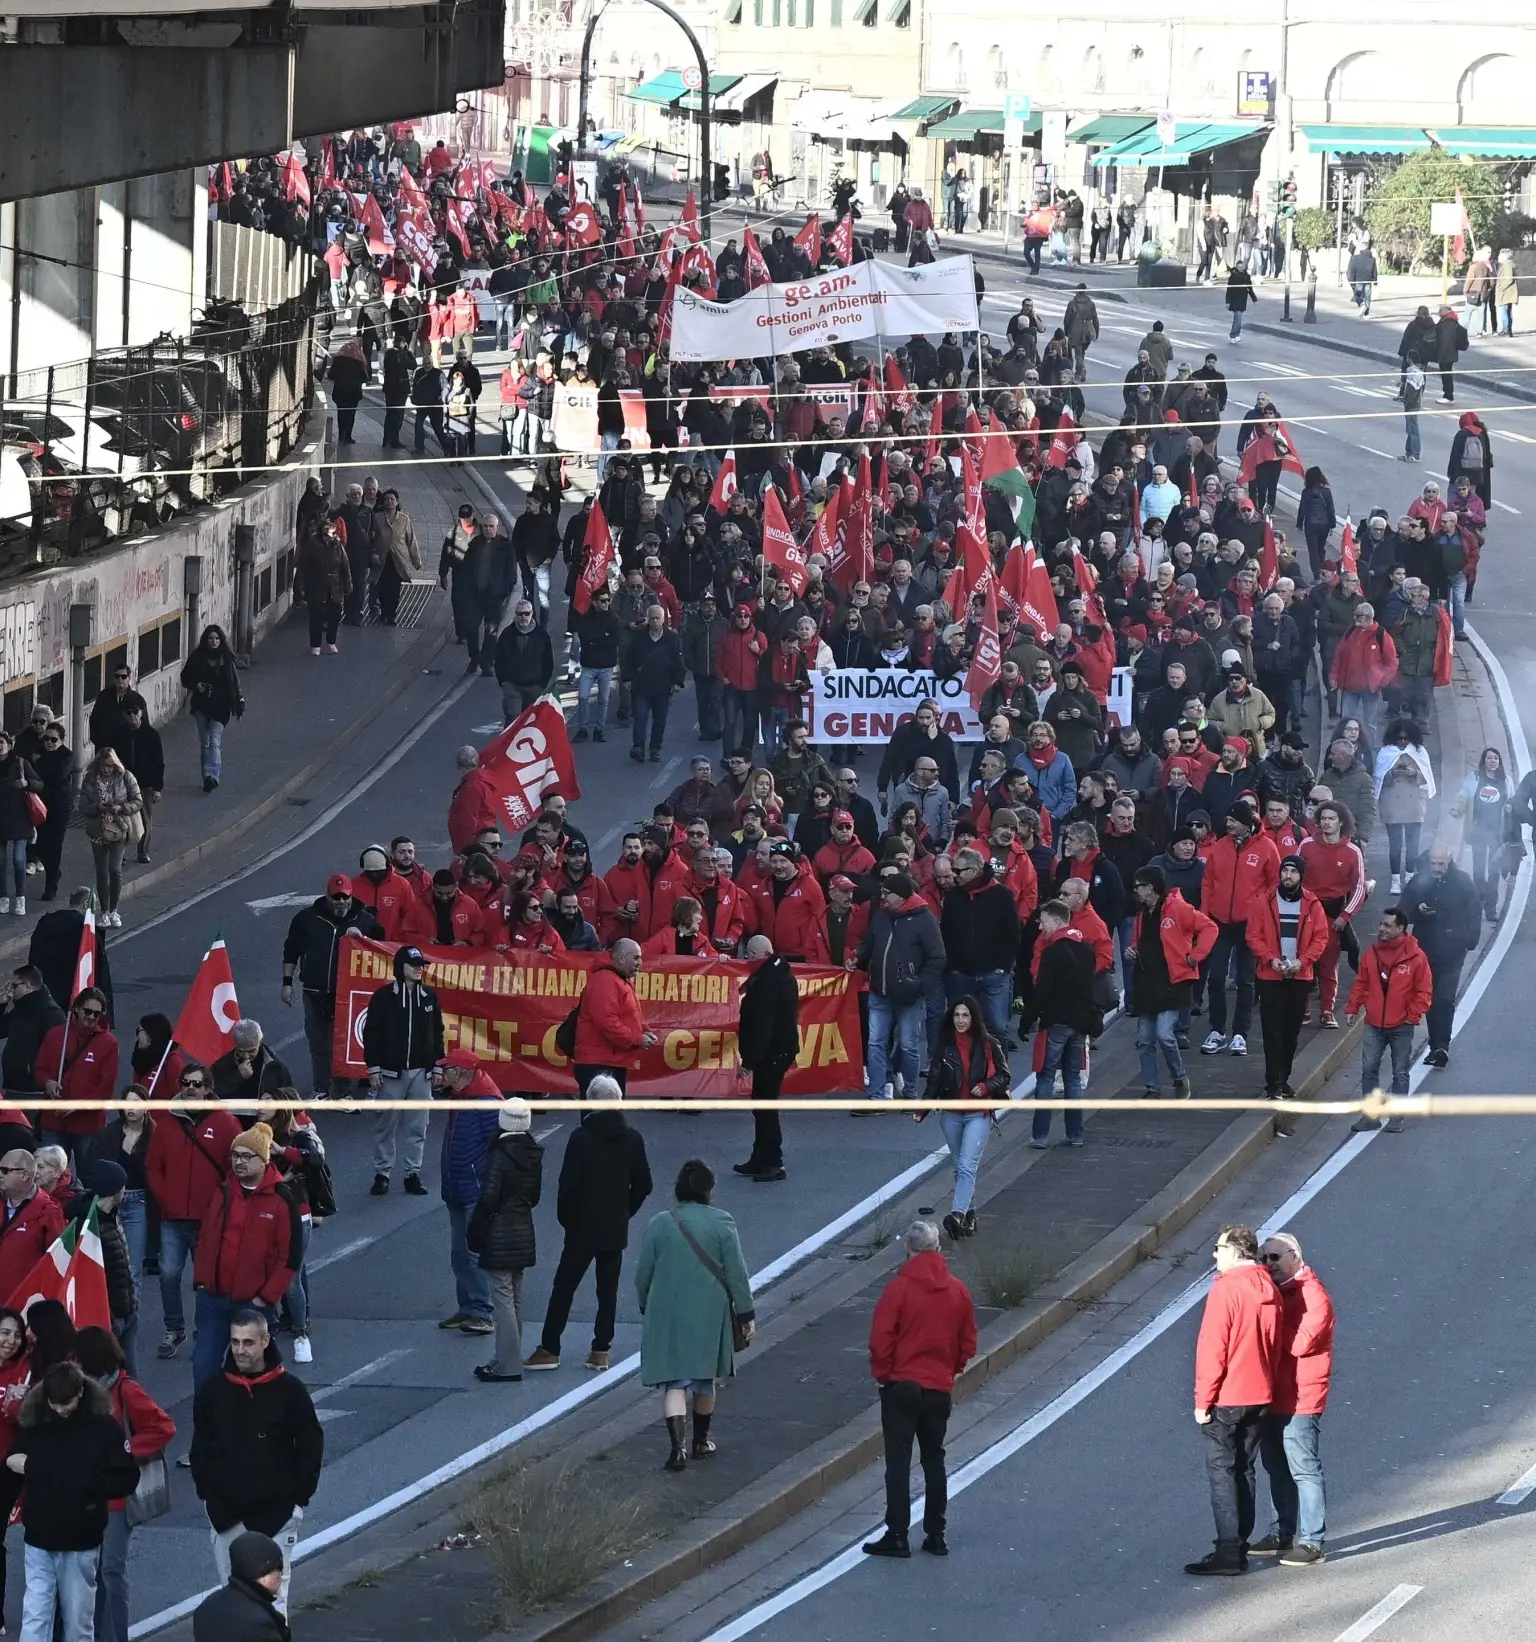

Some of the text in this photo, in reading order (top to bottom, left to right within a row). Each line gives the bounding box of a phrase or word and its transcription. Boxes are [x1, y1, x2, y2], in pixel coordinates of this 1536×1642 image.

[786, 271, 857, 307] ge.am.
[756, 291, 888, 328] Gestioni Ambientali
[789, 311, 863, 337] Genova Porto
[823, 675, 962, 699] SINDACATO
[664, 1022, 849, 1070] GENVA
